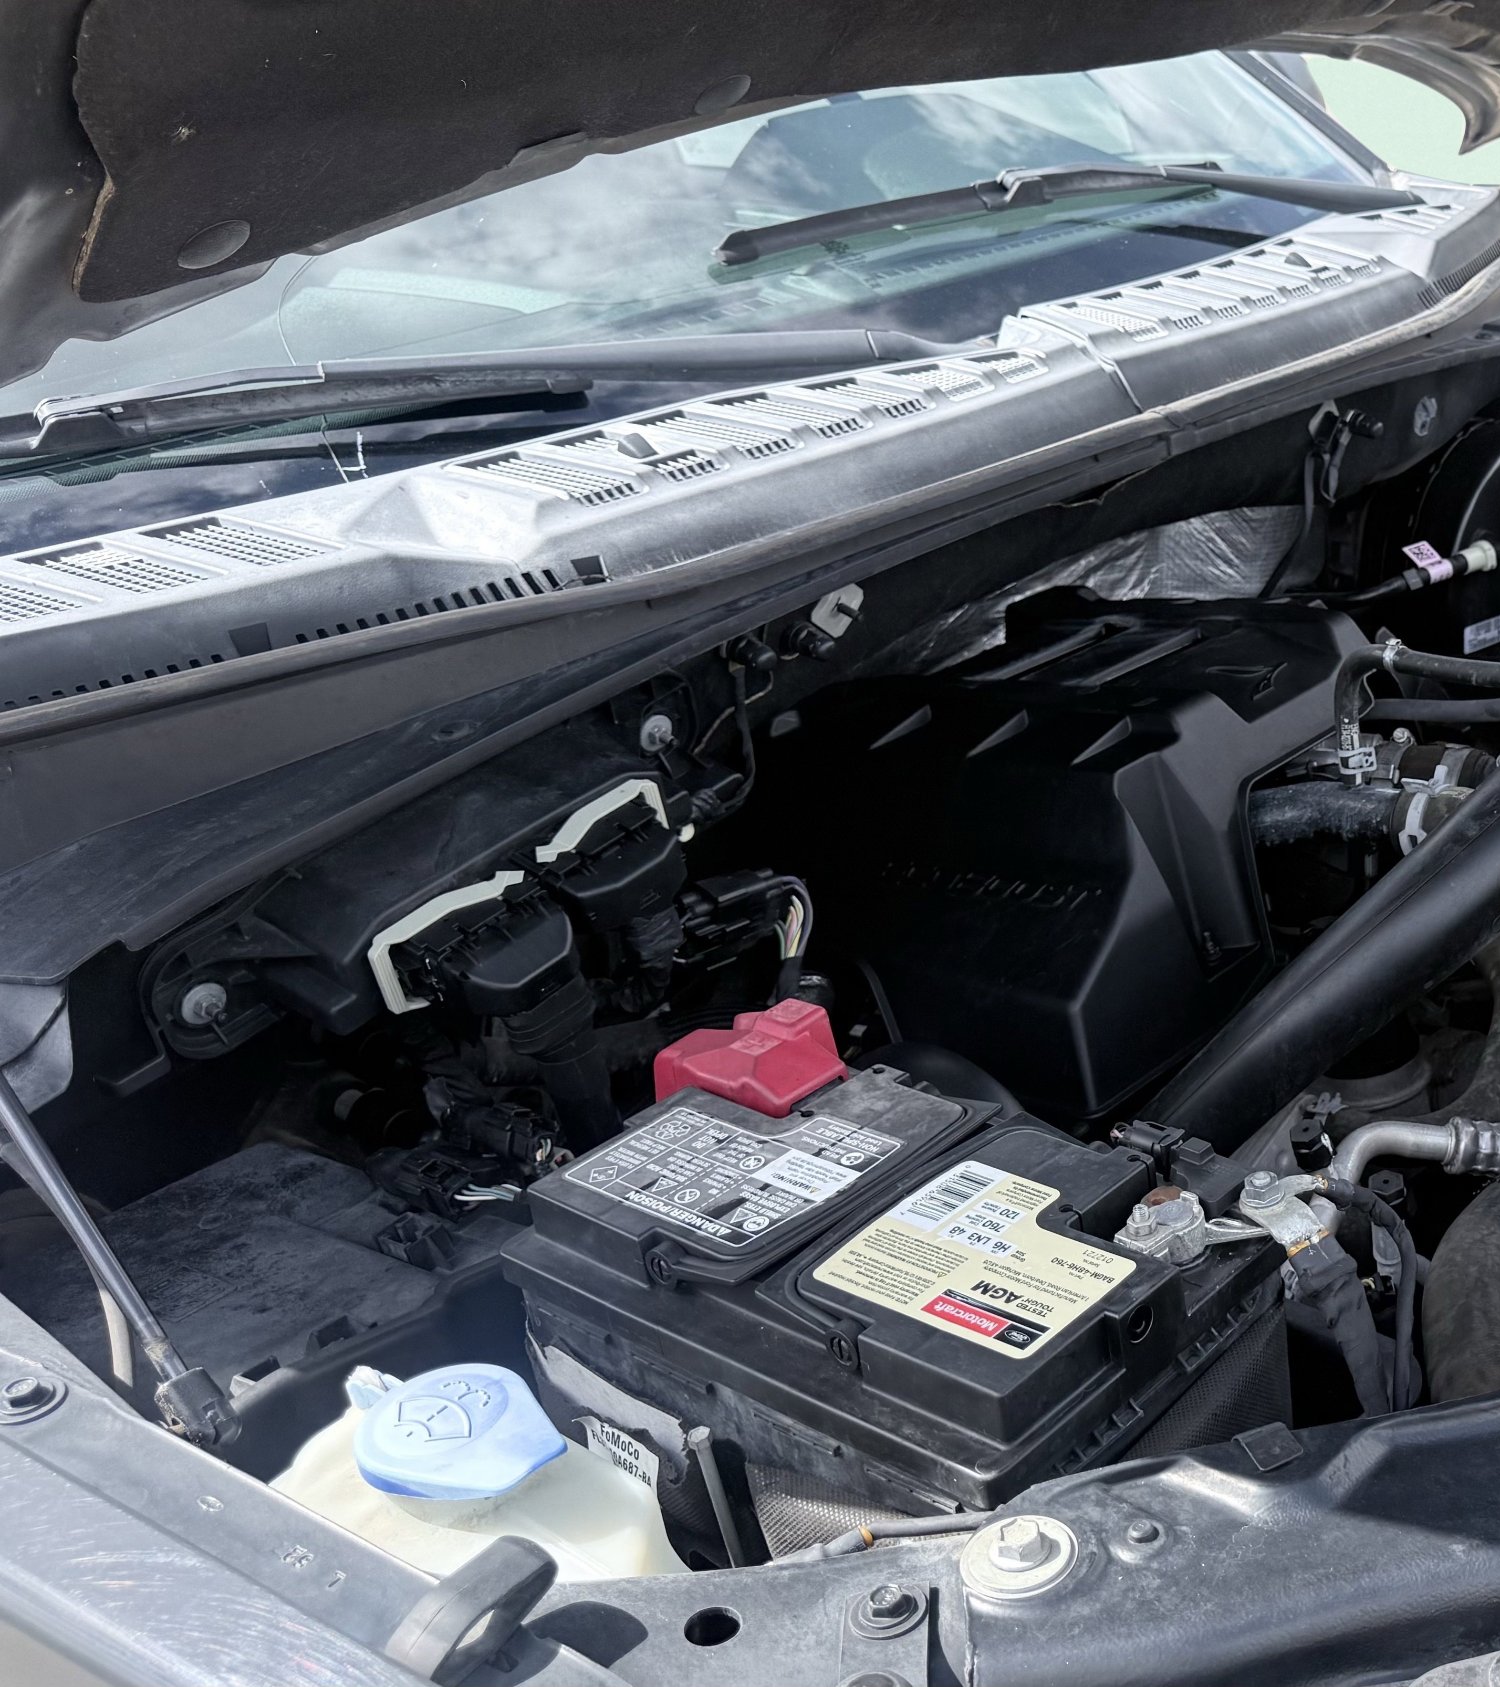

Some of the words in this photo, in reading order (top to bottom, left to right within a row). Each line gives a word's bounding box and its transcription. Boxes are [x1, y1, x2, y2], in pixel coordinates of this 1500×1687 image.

[690, 1140, 706, 1148] DO
[698, 1135, 718, 1143] NOT
[814, 1128, 881, 1151] NON-SPILLABLE
[623, 1191, 722, 1231] DANGER/POISON
[757, 1198, 790, 1212] EXPLOSIVE
[758, 1208, 781, 1218] SHIELD
[998, 1208, 1019, 1219] 120
[949, 1226, 967, 1236] 48
[981, 1220, 1006, 1232] 760
[967, 1232, 990, 1244] LN3
[991, 1241, 1011, 1251] H6
[1082, 1249, 1113, 1263] 012721
[982, 1265, 1008, 1277] Company
[997, 1264, 1021, 1275] Michigan
[1050, 1257, 1114, 1283] BAGM-48H6-760
[1005, 1274, 1021, 1282] Motor
[970, 1280, 1023, 1304] AGM
[1040, 1287, 1077, 1303] Manufactured
[1060, 1288, 1086, 1299] American
[1015, 1302, 1048, 1316] TESTED
[932, 1301, 998, 1330] Motorcraft
[600, 1424, 640, 1461] FoMoCo
